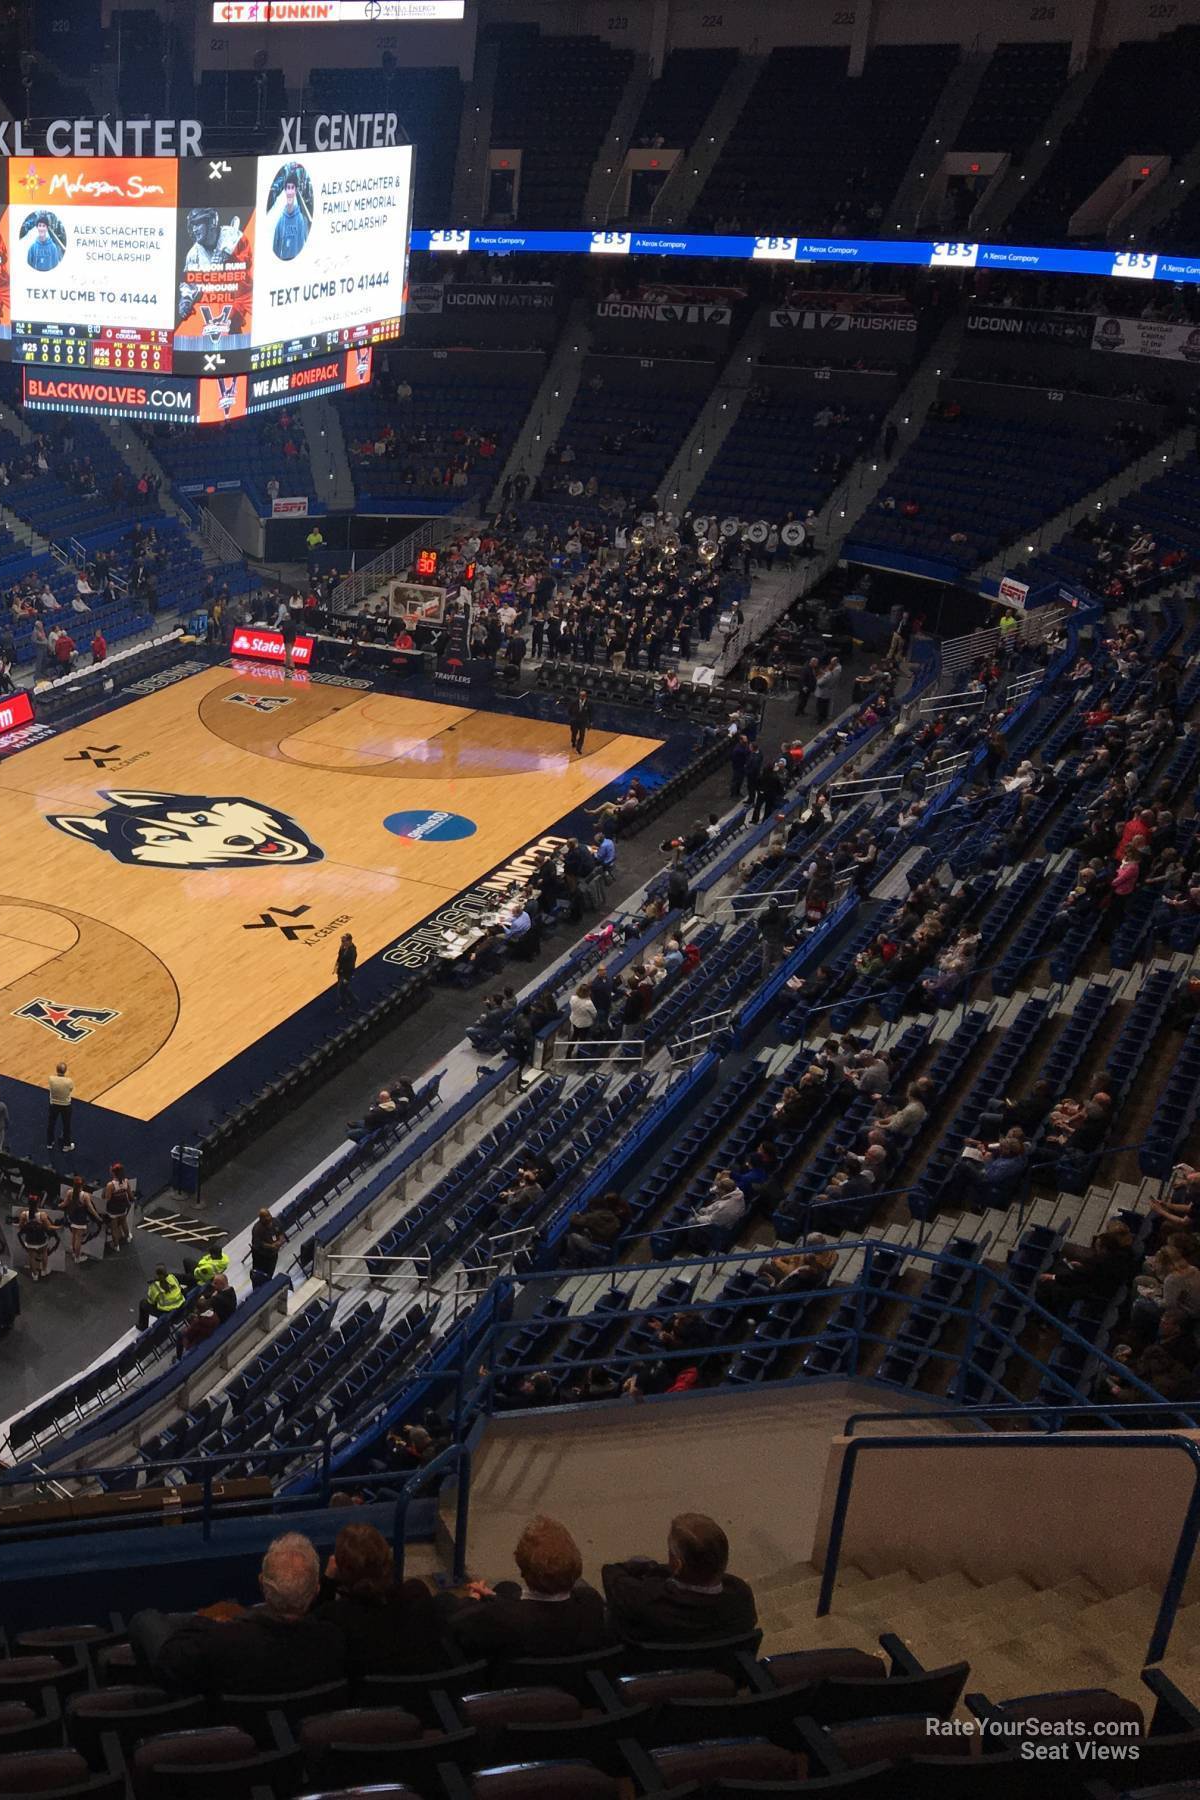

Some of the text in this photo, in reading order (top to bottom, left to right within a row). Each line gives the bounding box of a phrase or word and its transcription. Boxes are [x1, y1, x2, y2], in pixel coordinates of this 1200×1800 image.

[264, 5, 333, 19] DUNKIN'
[46, 120, 203, 156] CENTER
[278, 112, 398, 154] XL CENTER
[127, 176, 164, 198] Sun
[321, 176, 400, 196] ALEX SCHACHTER &
[322, 196, 396, 214] FAMILY MEMORIAL
[330, 215, 388, 234] SCHOLARSHIP
[74, 226, 164, 236] ALEX SCHACHTER &
[76, 238, 160, 250] FAMILY MEMORIAL
[497, 237, 526, 246] Company
[658, 241, 686, 249] Company
[86, 252, 151, 262] SCHOLARSHIP
[828, 246, 858, 256] Company
[1008, 254, 1039, 264] Company
[226, 262, 246, 270] RUNS
[1168, 264, 1185, 273] Xerox
[187, 272, 246, 282] DECEMBER
[198, 283, 238, 292] THROUGH
[270, 271, 390, 307] TEXT UCMB TO 41444
[26, 288, 158, 304] TEXT UCMB TO 41444
[200, 294, 234, 304] APRIL
[446, 294, 496, 306] UCONN
[596, 302, 657, 320] UCONN
[850, 318, 918, 332] HUSKIES
[967, 316, 1024, 333] UCONN
[69, 327, 76, 336] 0
[106, 329, 112, 338] 0
[344, 329, 348, 340] 0
[312, 337, 316, 348] 0
[22, 343, 85, 355] #25 0 0 0 0
[94, 348, 160, 360] #24 0 0 0 0
[26, 352, 34, 360] #1
[94, 357, 110, 366] #25
[254, 363, 339, 398] WE ARE #ONEPACK
[28, 379, 191, 408] BLACKWOLVES.COM
[1048, 392, 1064, 401] 123
[274, 502, 306, 512] ESPN
[419, 559, 434, 573] 30
[1001, 583, 1026, 602] ESPN
[122, 660, 210, 694] UCONN
[434, 672, 471, 684] TRAVELERS
[11, 730, 57, 748] HEALTH
[407, 812, 449, 840] genius3D
[481, 836, 568, 891] UCONN
[242, 904, 316, 941] XL
[302, 914, 352, 947] XL CENTER
